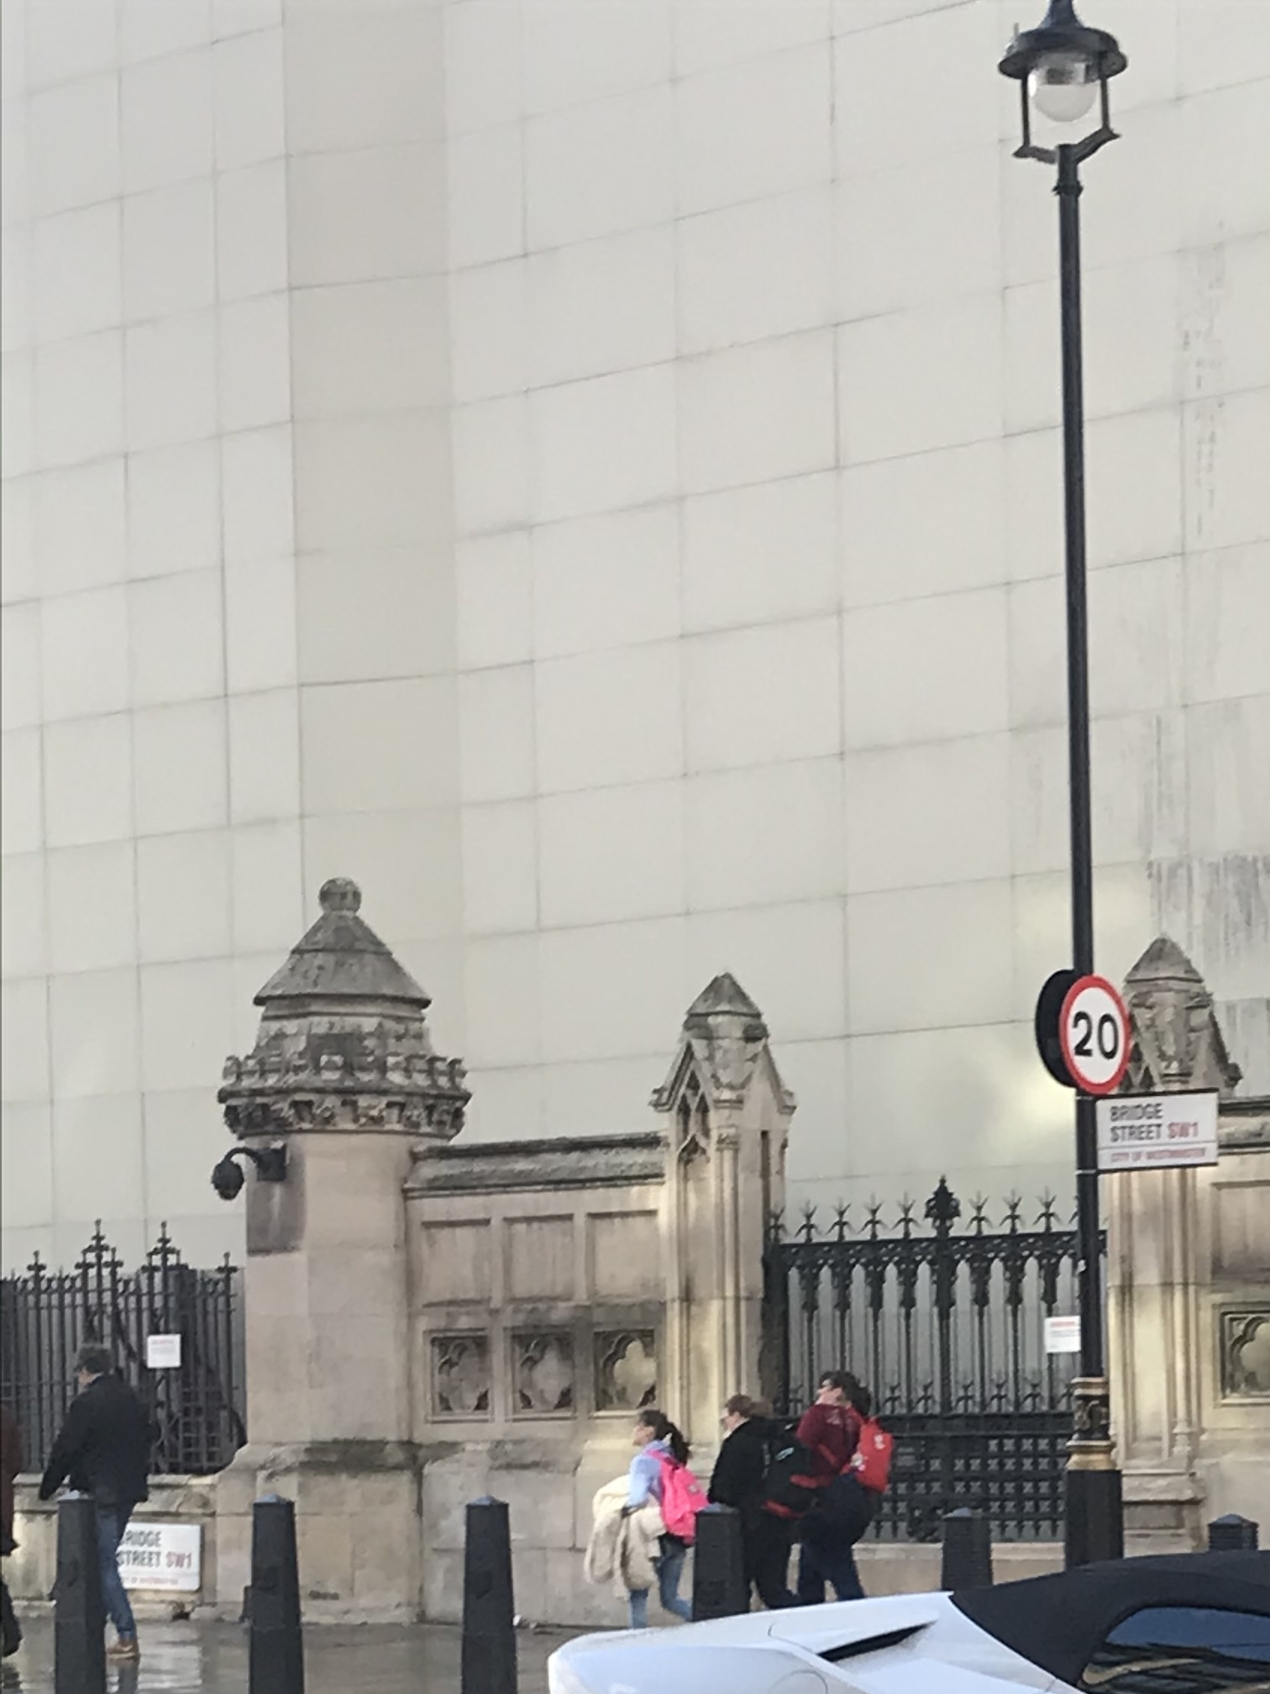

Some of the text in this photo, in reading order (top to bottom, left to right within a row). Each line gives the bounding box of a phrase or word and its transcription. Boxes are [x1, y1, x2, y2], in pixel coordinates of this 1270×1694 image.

[1073, 1010, 1119, 1060] 20
[1110, 1103, 1163, 1122] BRIDGE
[1110, 1121, 1198, 1142] STREET SW1
[116, 1550, 192, 1569] STREET SW1
